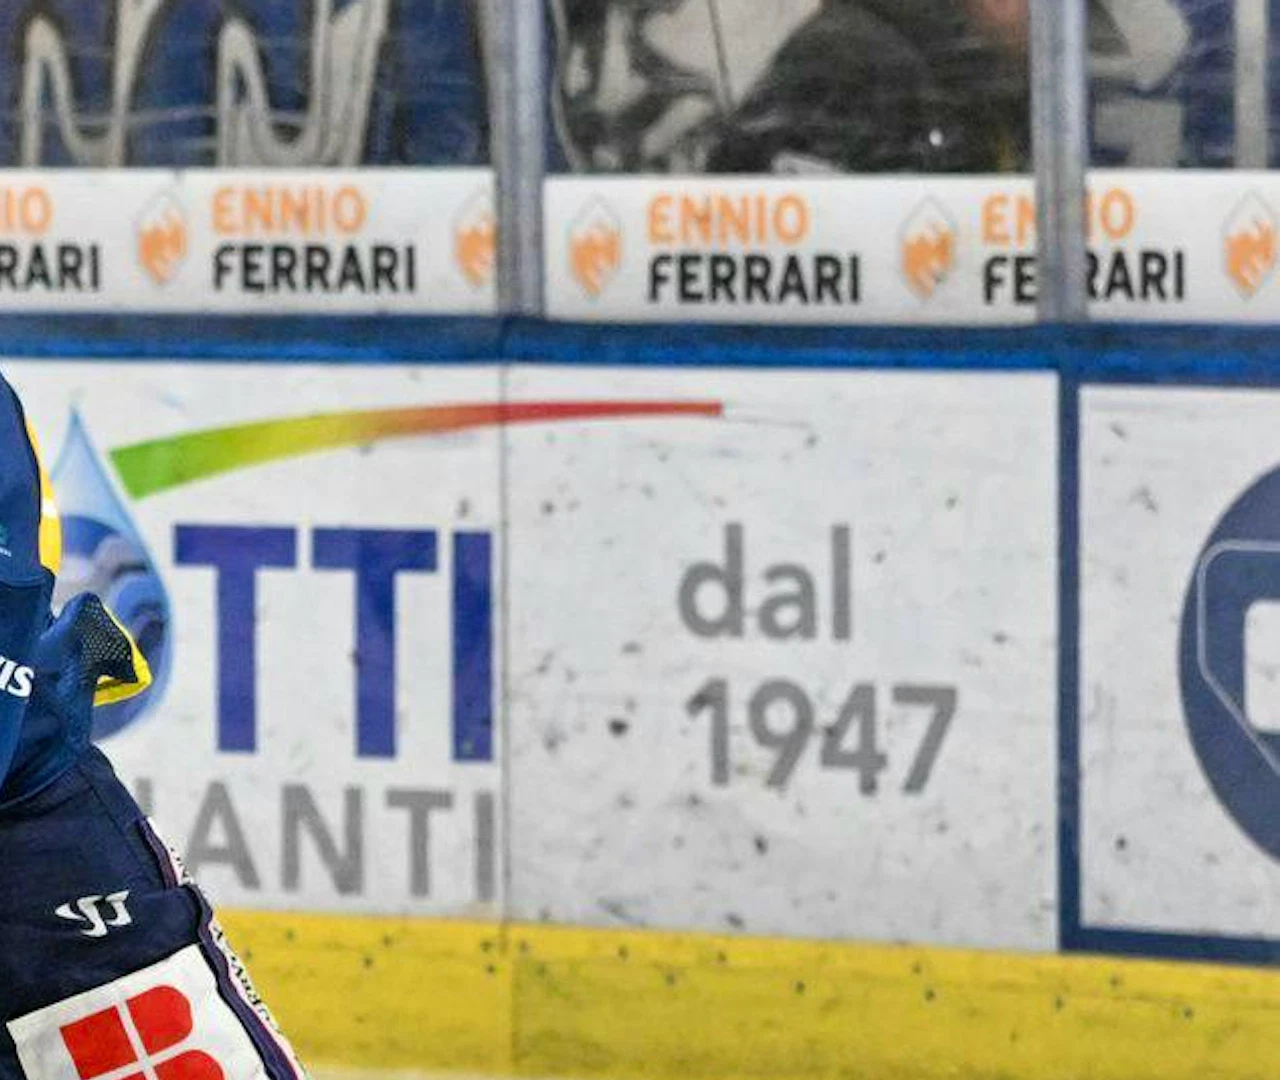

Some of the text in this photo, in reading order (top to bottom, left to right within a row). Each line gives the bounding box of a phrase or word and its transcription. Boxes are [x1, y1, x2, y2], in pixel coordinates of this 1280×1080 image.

[213, 187, 367, 236] ENNIO
[648, 194, 810, 245] ENNIO
[214, 245, 416, 292] FERRARI
[648, 254, 860, 304] FERRARI
[676, 521, 853, 641] dal
[172, 523, 495, 763] TTI
[685, 676, 959, 798] 1947
[137, 776, 496, 903] ANTI
